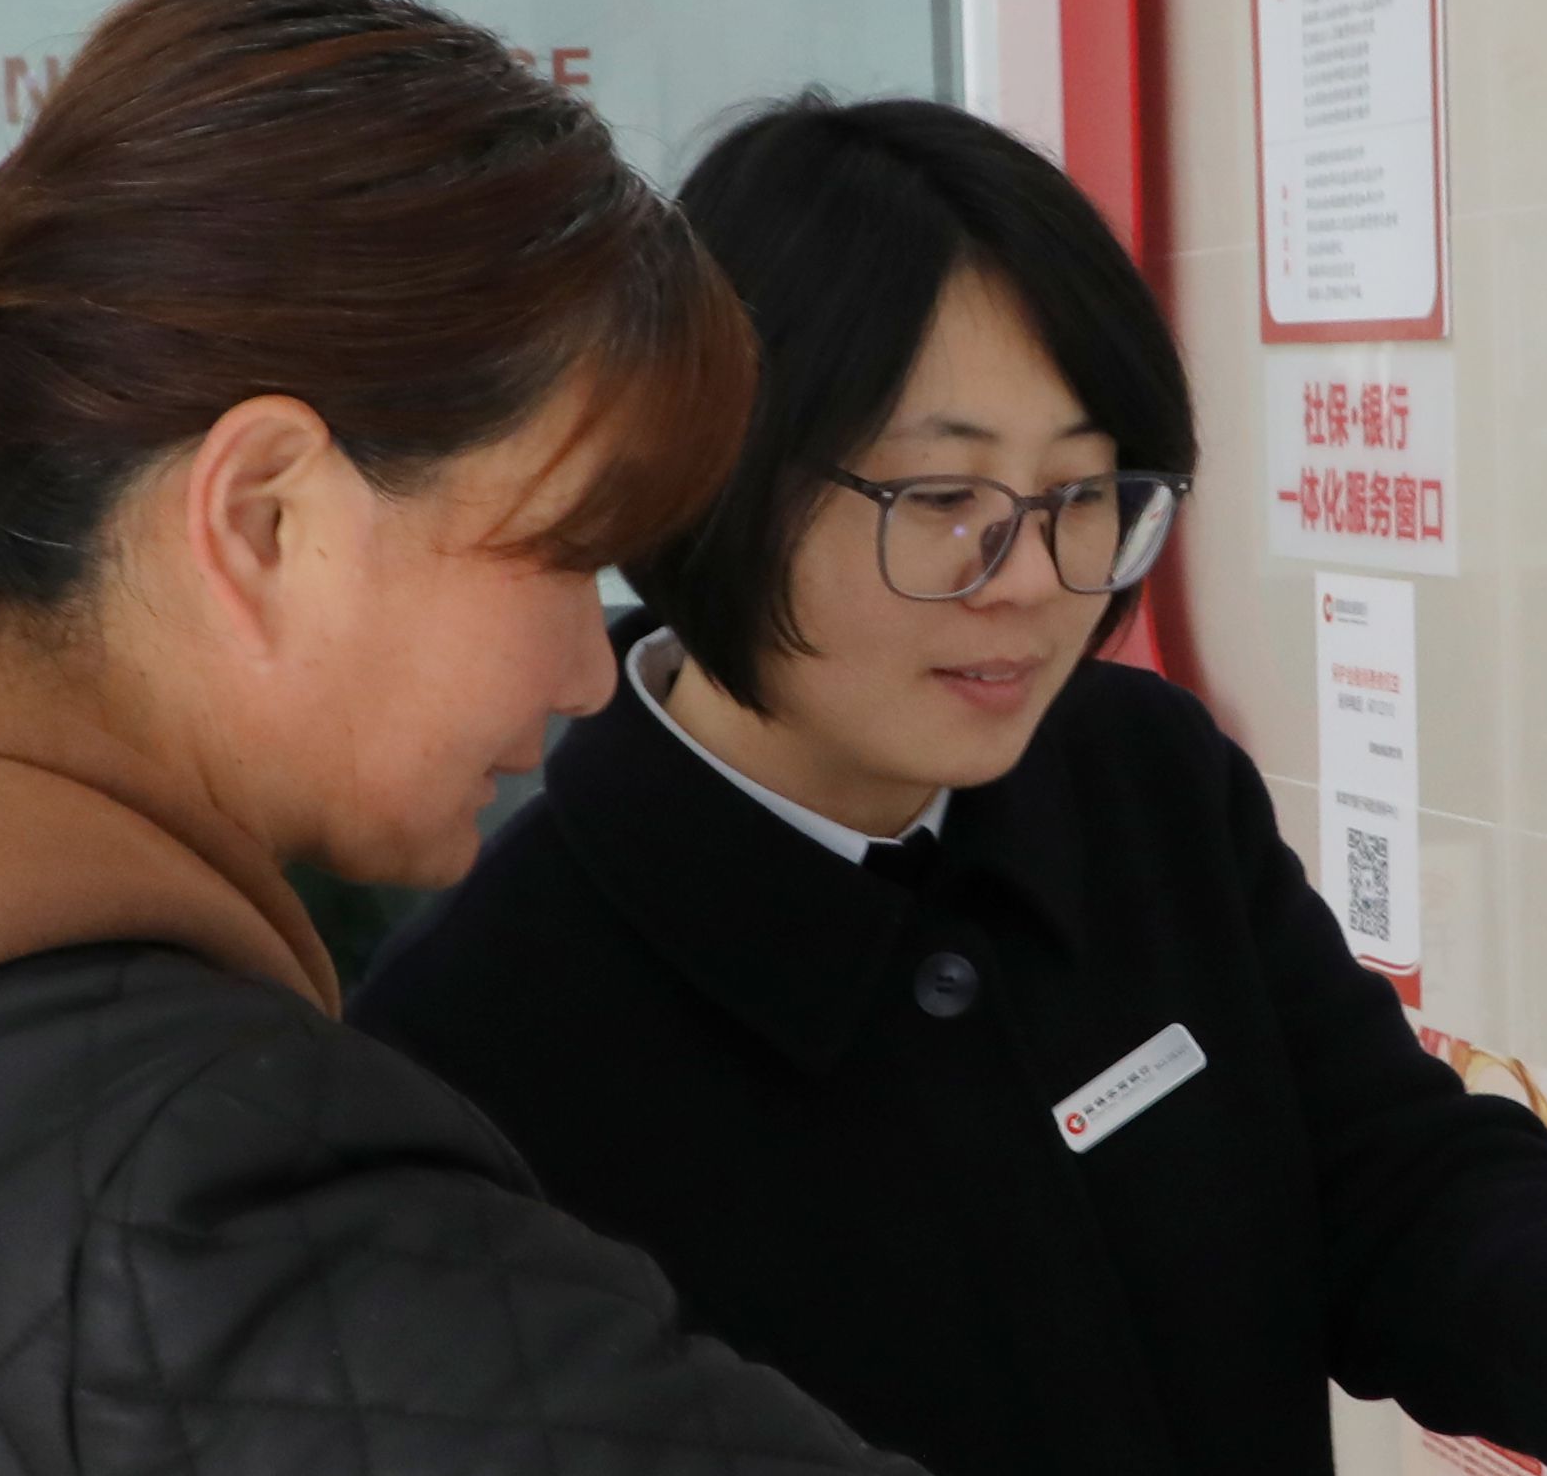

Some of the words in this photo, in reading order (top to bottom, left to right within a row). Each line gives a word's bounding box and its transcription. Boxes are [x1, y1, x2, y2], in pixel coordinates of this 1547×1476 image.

[1278, 467, 1444, 542] 一体化服务窗口
